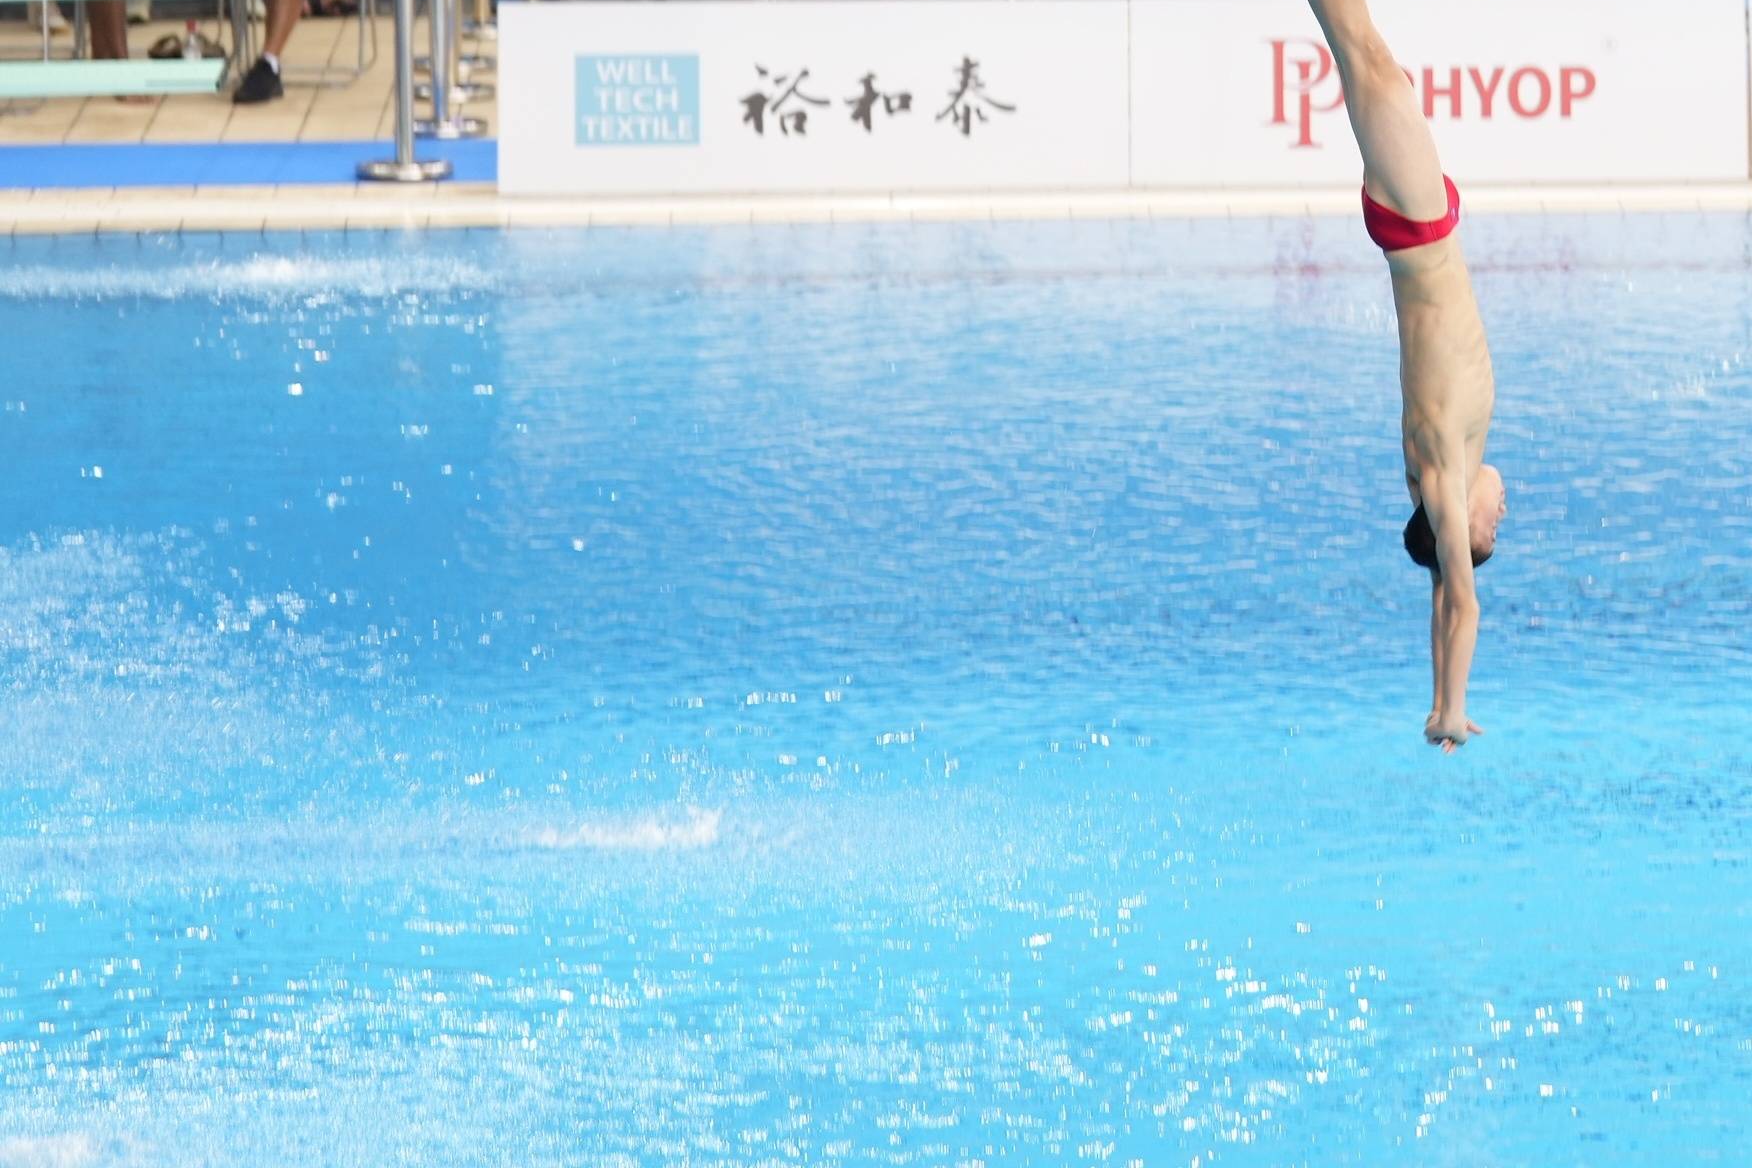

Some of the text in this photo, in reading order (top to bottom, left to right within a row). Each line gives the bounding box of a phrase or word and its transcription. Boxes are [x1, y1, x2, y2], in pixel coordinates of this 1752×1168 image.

[596, 58, 676, 85] WELL
[593, 86, 680, 113] TECH
[740, 54, 1017, 137] 裕和泰
[1404, 64, 1597, 120] HYOP
[581, 113, 694, 141] TEXTILE
